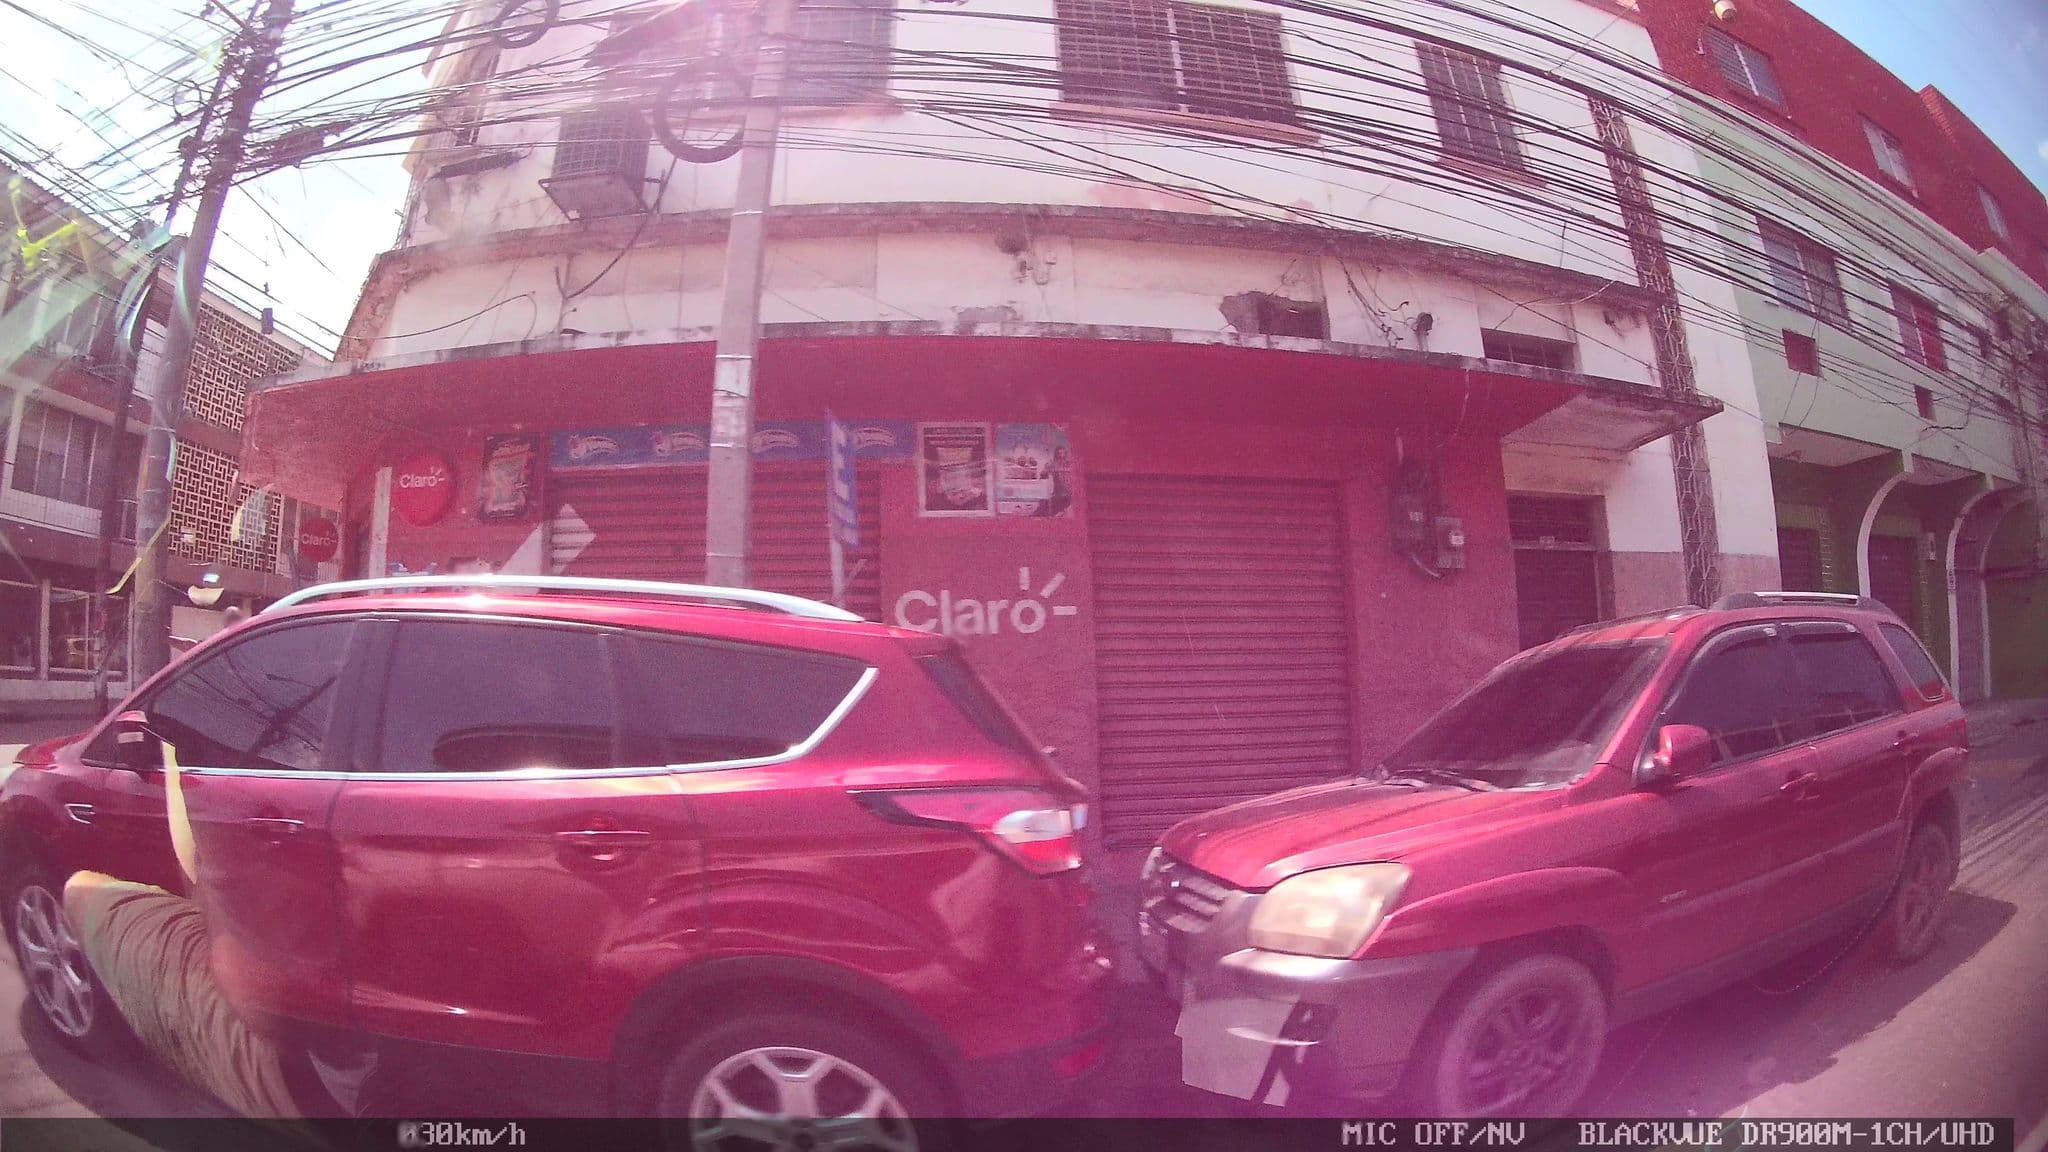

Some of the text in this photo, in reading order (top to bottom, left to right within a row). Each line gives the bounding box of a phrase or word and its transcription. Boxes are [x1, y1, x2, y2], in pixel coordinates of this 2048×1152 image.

[400, 472, 440, 488] Claro
[301, 532, 331, 546] Claro
[895, 588, 1047, 635] Claro
